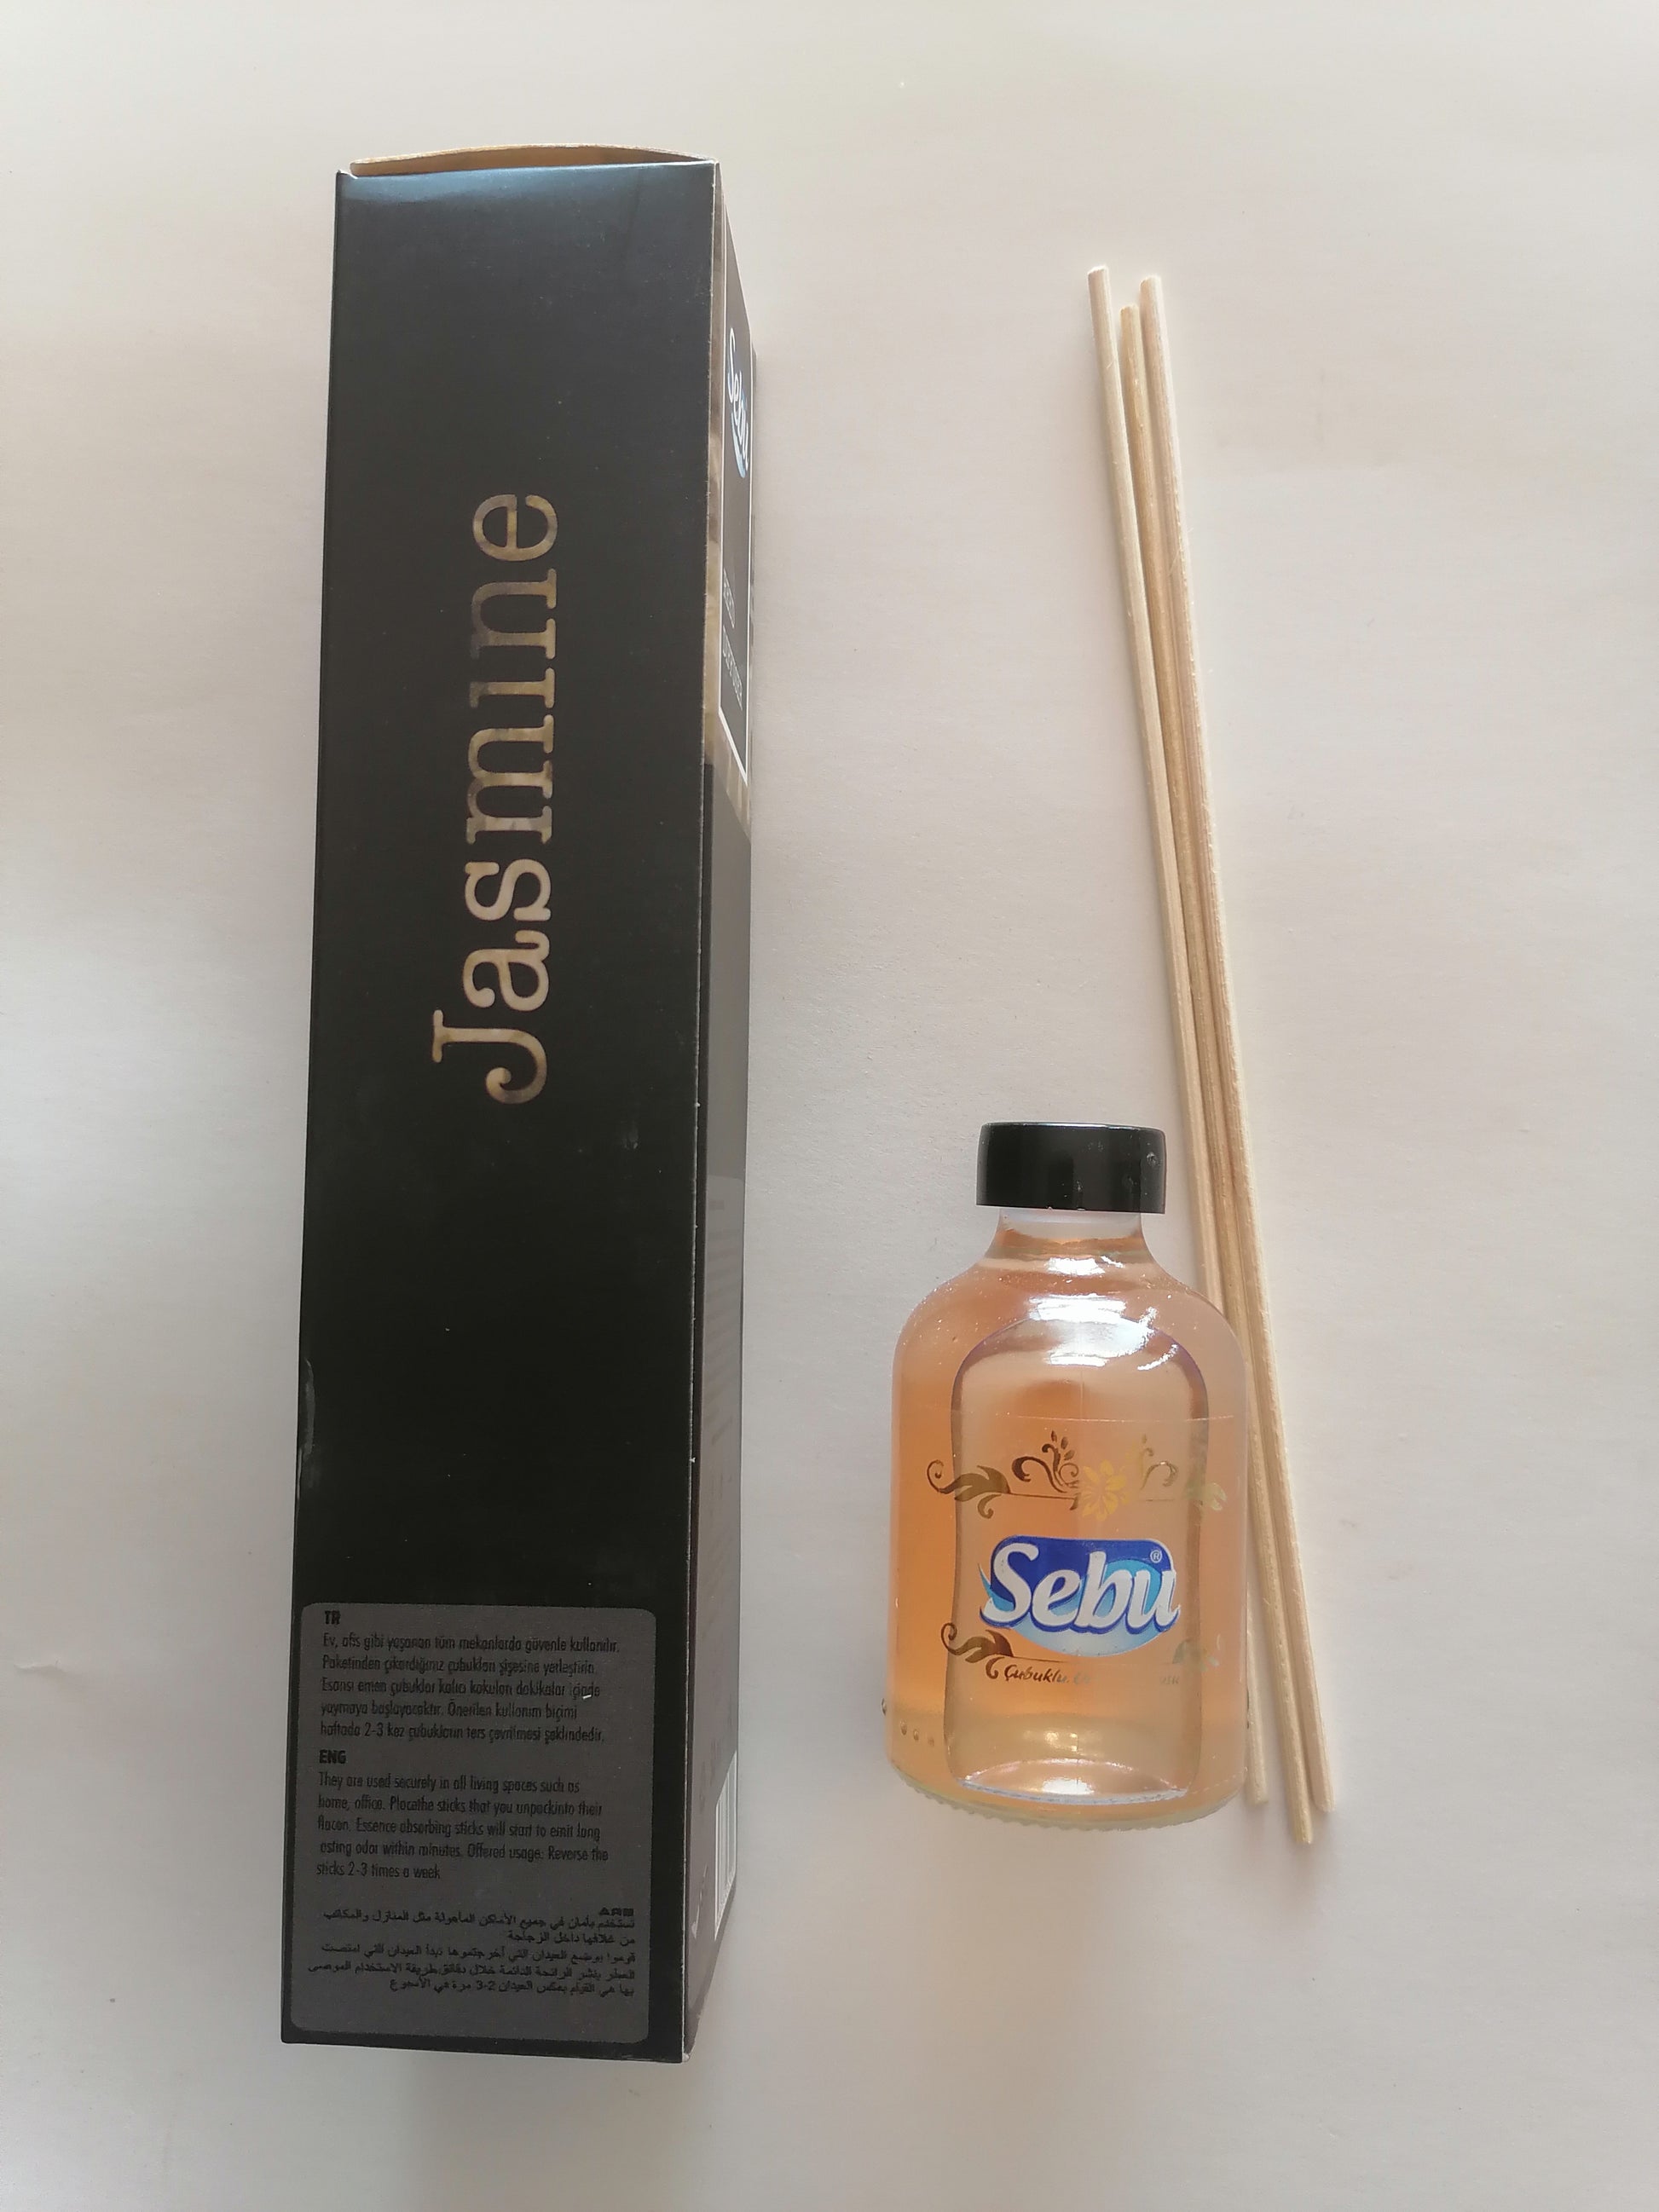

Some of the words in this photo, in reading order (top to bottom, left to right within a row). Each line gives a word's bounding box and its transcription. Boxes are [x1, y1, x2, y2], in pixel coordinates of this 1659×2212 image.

[727, 326, 749, 471] Sebu
[980, 1542, 1181, 1632] Sebu
[325, 1610, 341, 1625] TR
[323, 1632, 338, 1648] Ev,
[364, 1632, 384, 1650] gibi
[435, 1635, 454, 1649] tüm
[460, 1636, 521, 1650] mekanlarda
[525, 1636, 566, 1654] güvenle
[570, 1637, 620, 1653] kullanılır.
[322, 1655, 380, 1669] Paketinden
[384, 1655, 443, 1674] çıkardığınız
[500, 1660, 539, 1676] şişesine
[321, 1677, 354, 1691] Esansı
[358, 1682, 386, 1692] emen
[390, 1678, 435, 1695] çubuklar
[517, 1680, 564, 1695] dakikalar
[321, 1703, 367, 1716] yaymaya
[495, 1702, 541, 1718] kullanım
[321, 1721, 360, 1736] haftada
[365, 1723, 384, 1736] 2-3
[388, 1723, 404, 1737] kez
[467, 1728, 486, 1739] ters
[319, 1750, 346, 1764] ENG
[319, 1772, 342, 1790] They
[347, 1776, 363, 1787] are
[367, 1773, 390, 1788] used
[395, 1775, 436, 1792] securely
[440, 1776, 449, 1788] in
[454, 1775, 466, 1790] all
[471, 1776, 499, 1793] living
[503, 1780, 537, 1794] spaces
[540, 1777, 564, 1792] such
[568, 1782, 580, 1793] as
[318, 1794, 350, 1811] home,
[355, 1794, 384, 1810] office.
[436, 1798, 465, 1812] sticks
[470, 1799, 491, 1813] that
[494, 1803, 512, 1816] you
[578, 1800, 602, 1816] their
[356, 1818, 396, 1833] Essence
[400, 1819, 451, 1837] absorbing
[455, 1822, 483, 1835] sticks
[487, 1822, 505, 1836] will
[509, 1824, 532, 1837] start
[536, 1825, 546, 1837] to
[550, 1825, 574, 1839] emit
[577, 1823, 600, 1841] long
[356, 1839, 379, 1854] odor
[384, 1841, 414, 1856] within
[468, 1843, 505, 1858] Offered
[548, 1845, 588, 1861] Reverse
[592, 1847, 609, 1861] the
[317, 1861, 344, 1875] sticks
[348, 1862, 367, 1876] 2-3
[372, 1863, 399, 1877] times
[403, 1868, 409, 1878] a
